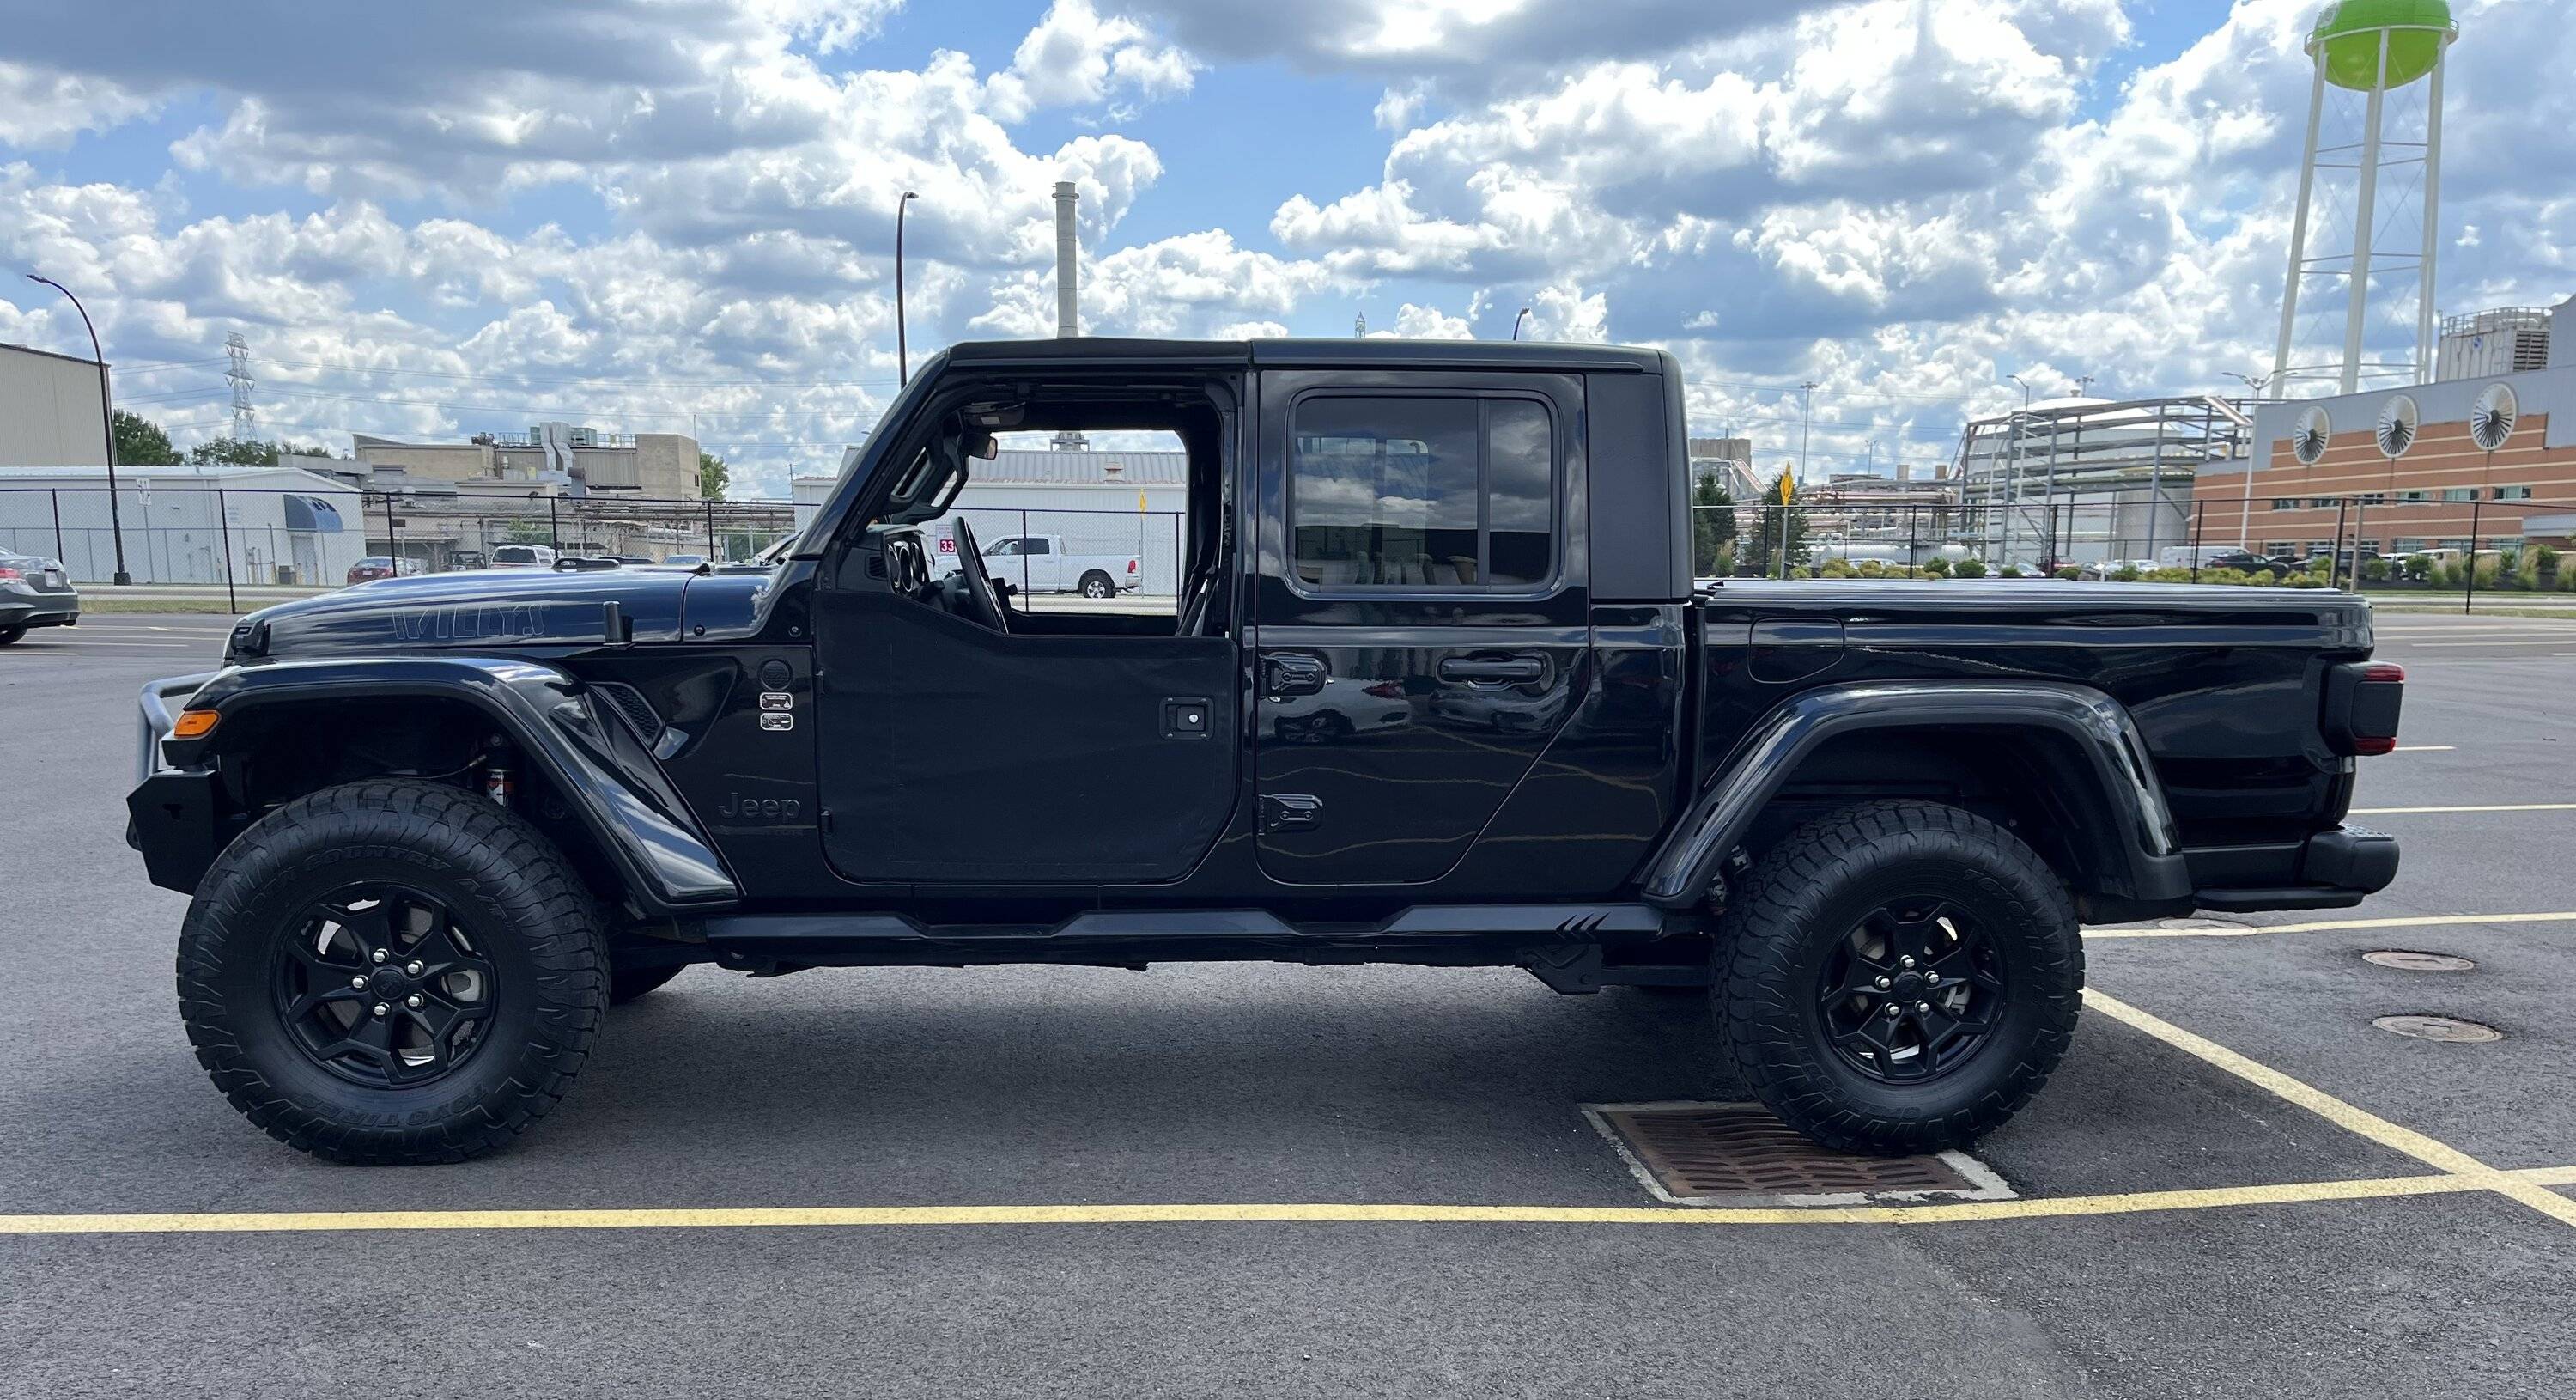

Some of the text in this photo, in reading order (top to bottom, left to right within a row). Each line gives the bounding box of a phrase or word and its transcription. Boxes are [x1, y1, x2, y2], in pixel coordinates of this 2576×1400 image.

[941, 540, 954, 551] 33
[392, 603, 550, 640] WILLYS
[717, 792, 801, 823] Jeep
[303, 843, 453, 872] COUNTRY
